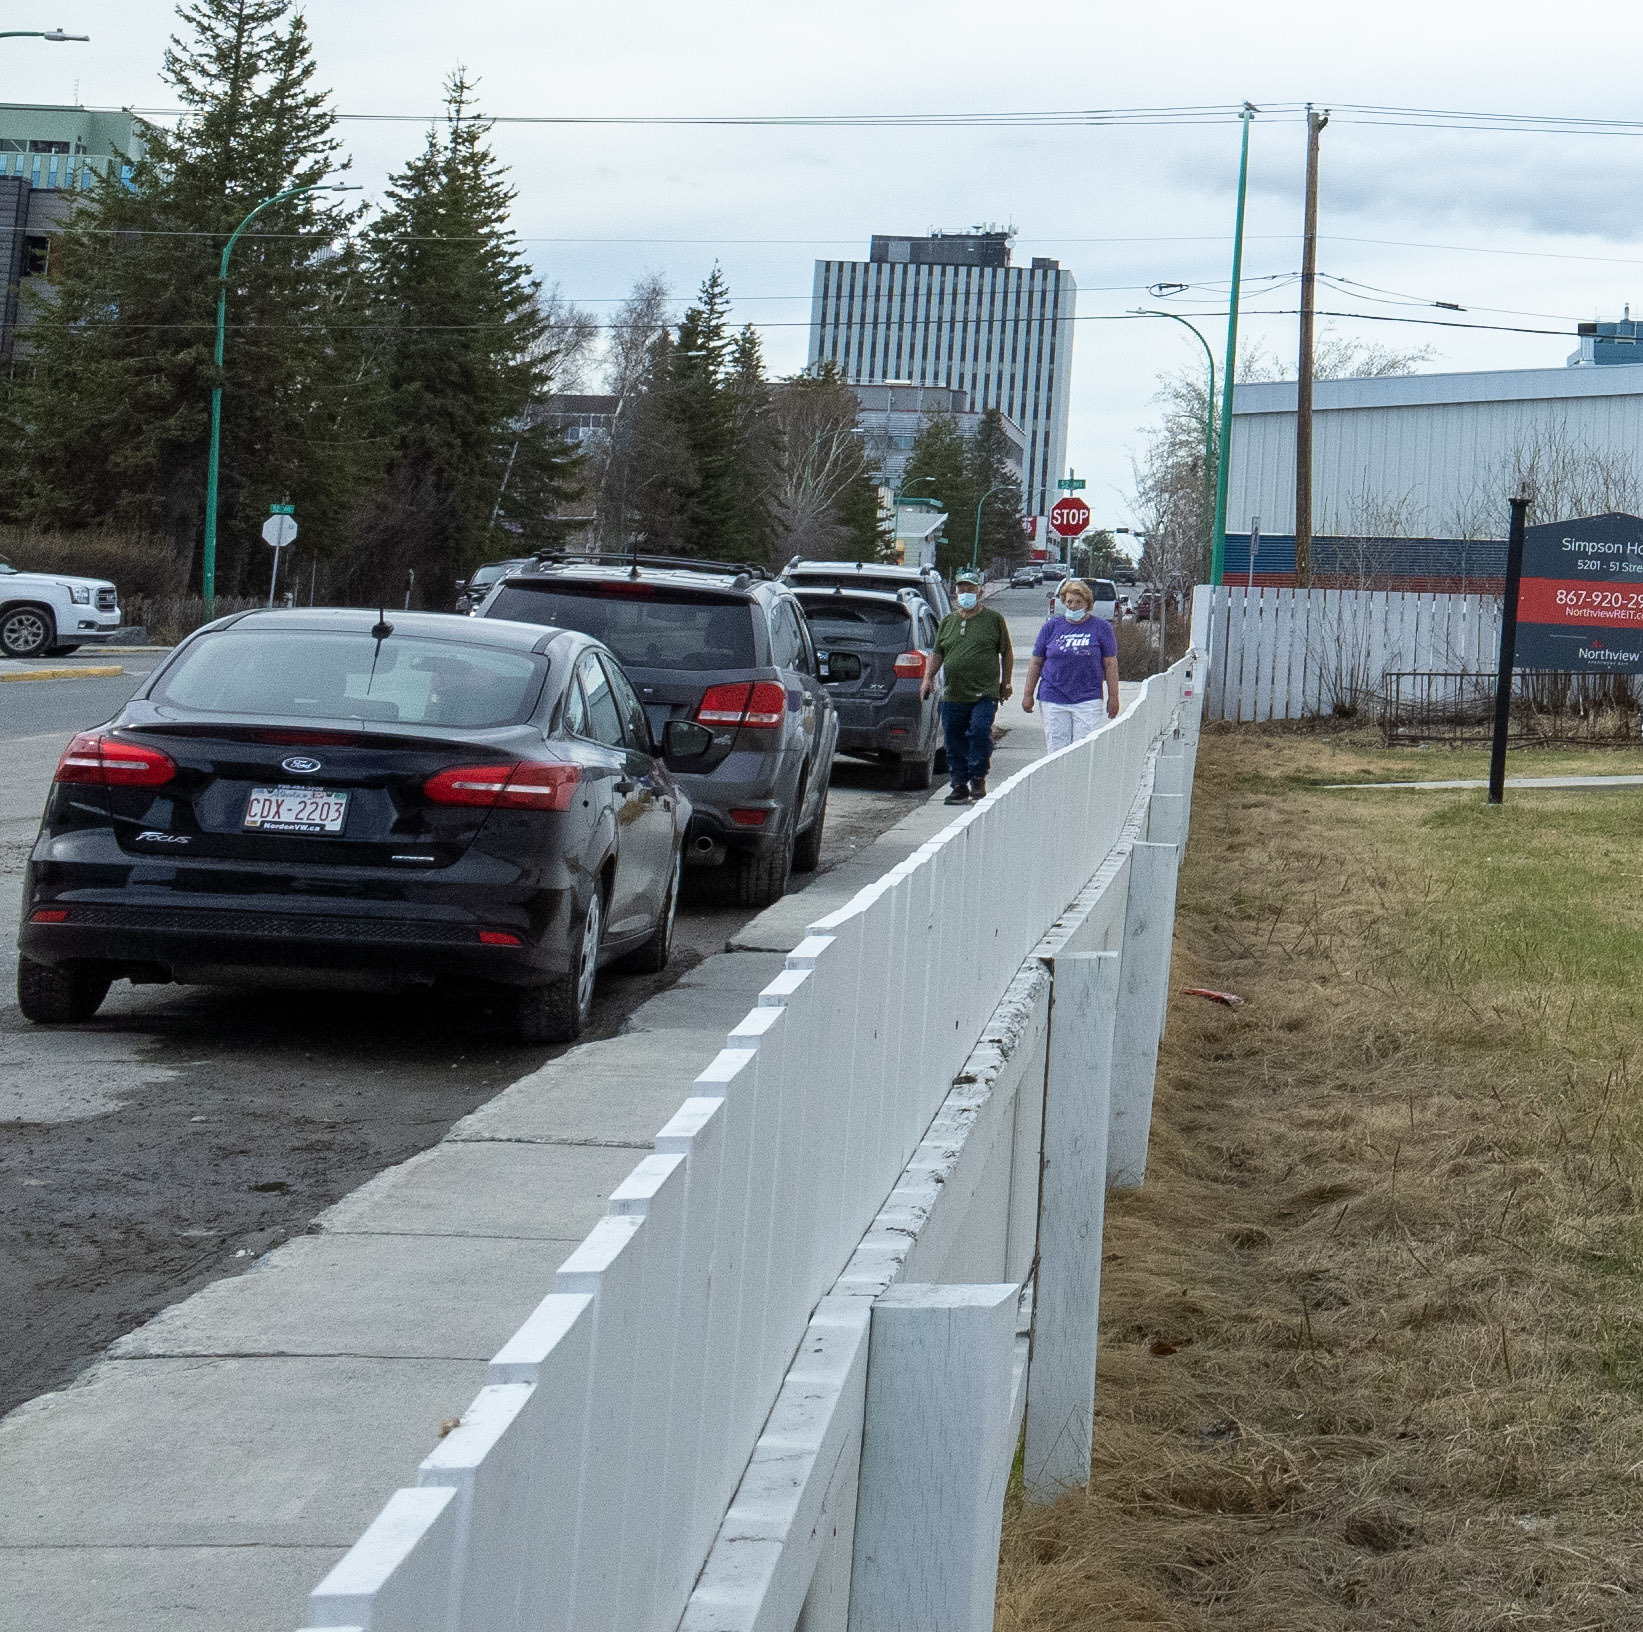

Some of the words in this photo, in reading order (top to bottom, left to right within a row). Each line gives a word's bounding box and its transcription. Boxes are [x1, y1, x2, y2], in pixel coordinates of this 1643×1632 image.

[1052, 509, 1089, 525] STOP
[1561, 537, 1623, 556] Simpson
[1577, 559, 1601, 571] 5201
[1609, 561, 1620, 572] 51
[1578, 648, 1641, 662] Northview
[248, 798, 344, 823] CDX-2203
